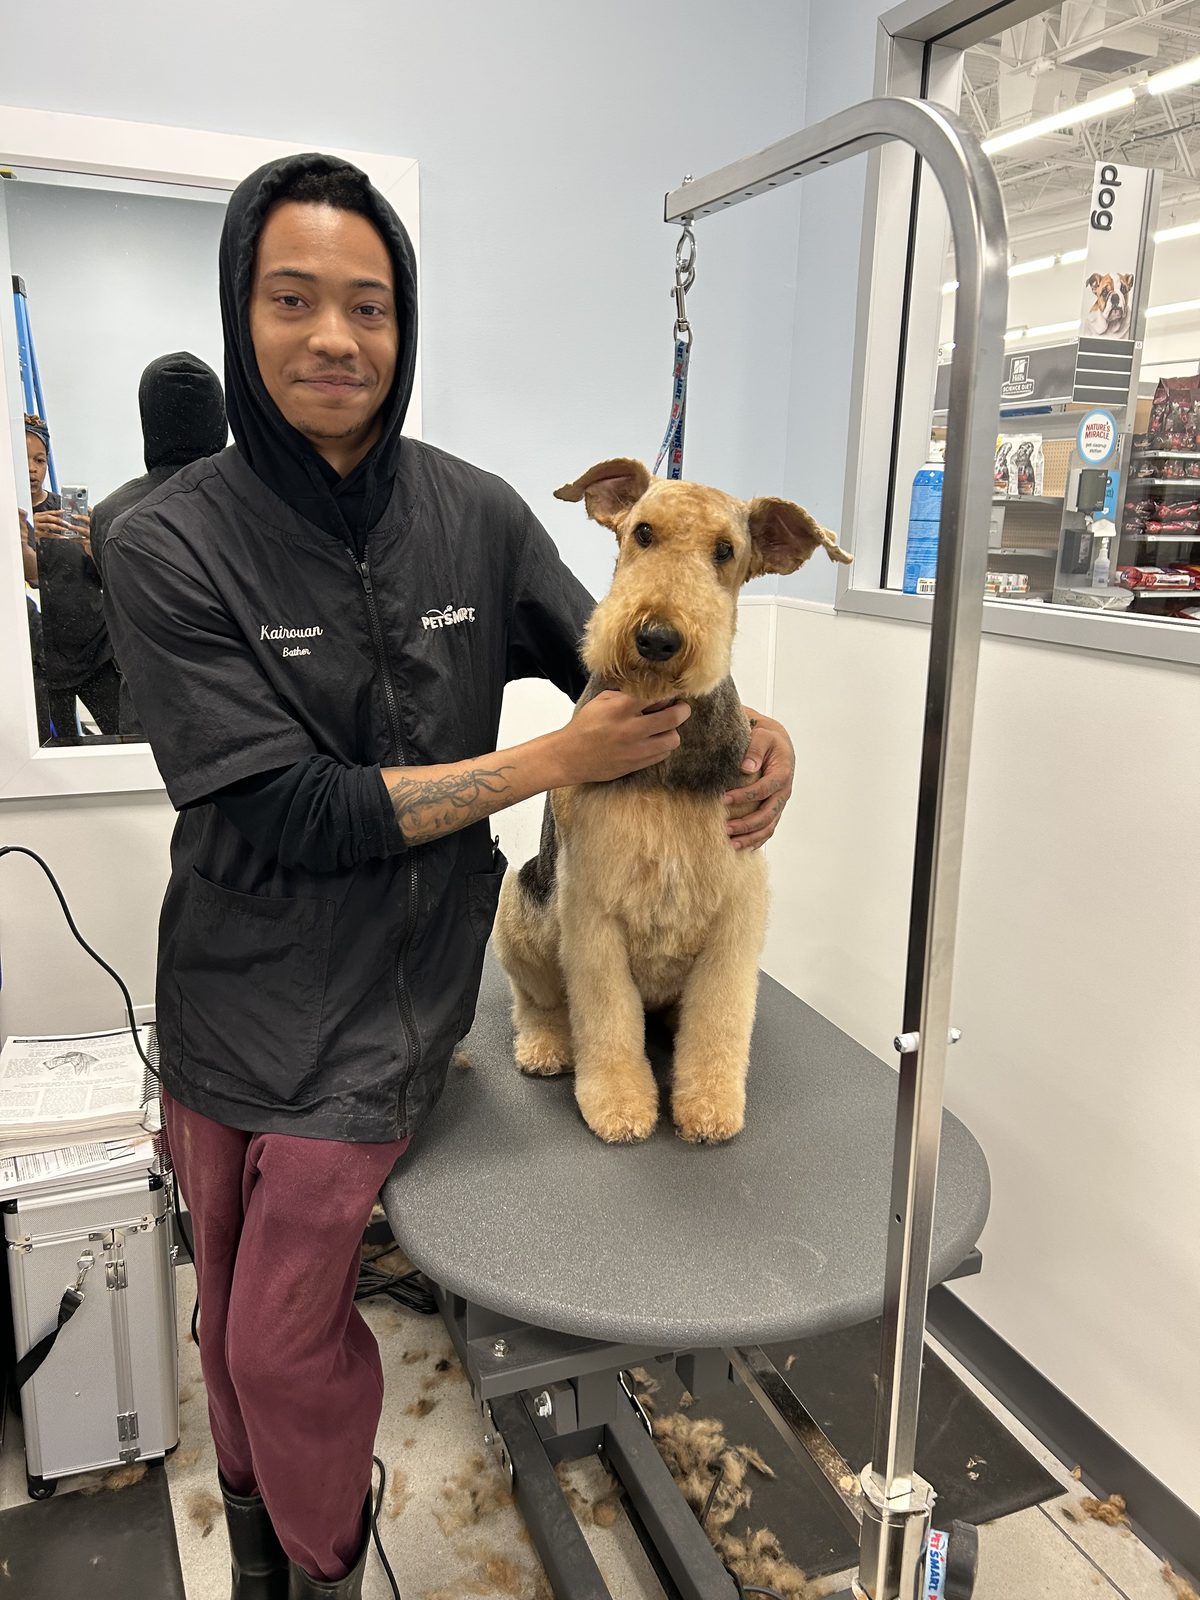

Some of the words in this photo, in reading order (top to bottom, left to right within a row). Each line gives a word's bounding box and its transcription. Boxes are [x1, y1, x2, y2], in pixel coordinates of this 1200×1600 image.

[1091, 164, 1122, 231] dog
[1002, 384, 1021, 392] SCIENCE
[1085, 422, 1111, 432] NATURE'S
[1085, 430, 1110, 440] MIRACLE
[259, 624, 323, 641] Kairouan
[282, 646, 312, 657] Bather
